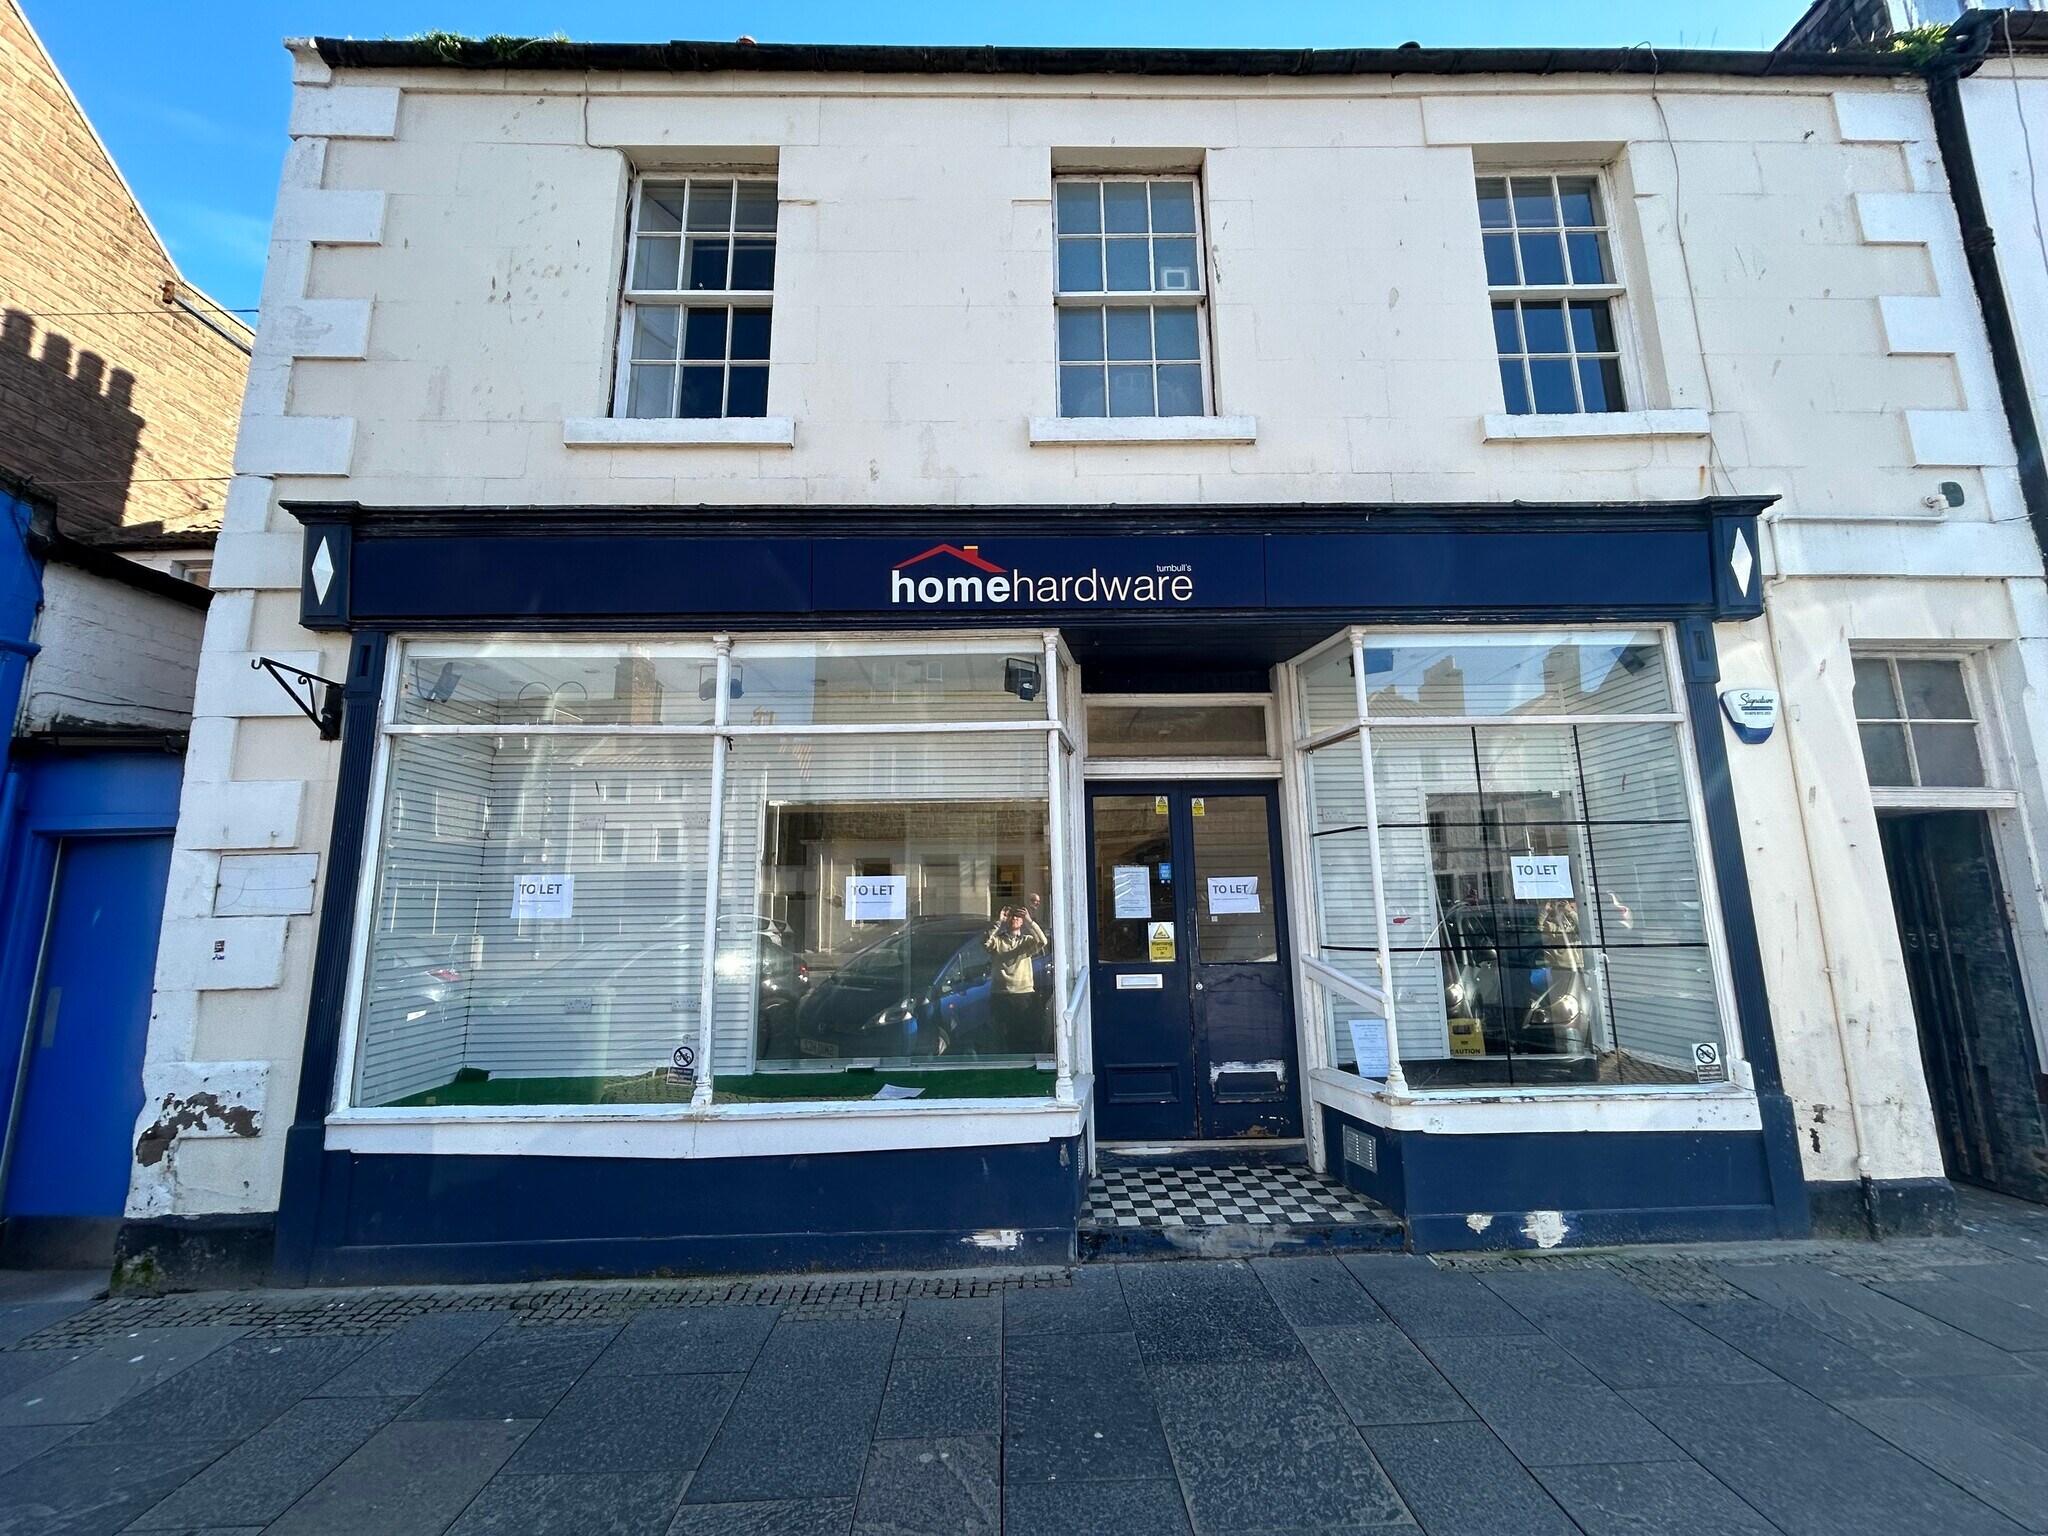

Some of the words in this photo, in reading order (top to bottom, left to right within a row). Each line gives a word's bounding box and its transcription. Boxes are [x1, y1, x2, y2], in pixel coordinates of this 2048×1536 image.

[1739, 693, 1773, 706] Signature
[1517, 865, 1533, 875] TO
[1536, 865, 1557, 875] LET
[519, 884, 536, 894] TO
[539, 884, 562, 894] LET
[851, 885, 868, 896] TO
[872, 885, 895, 896] LET
[1212, 885, 1227, 894] TO
[1230, 884, 1248, 894] LET
